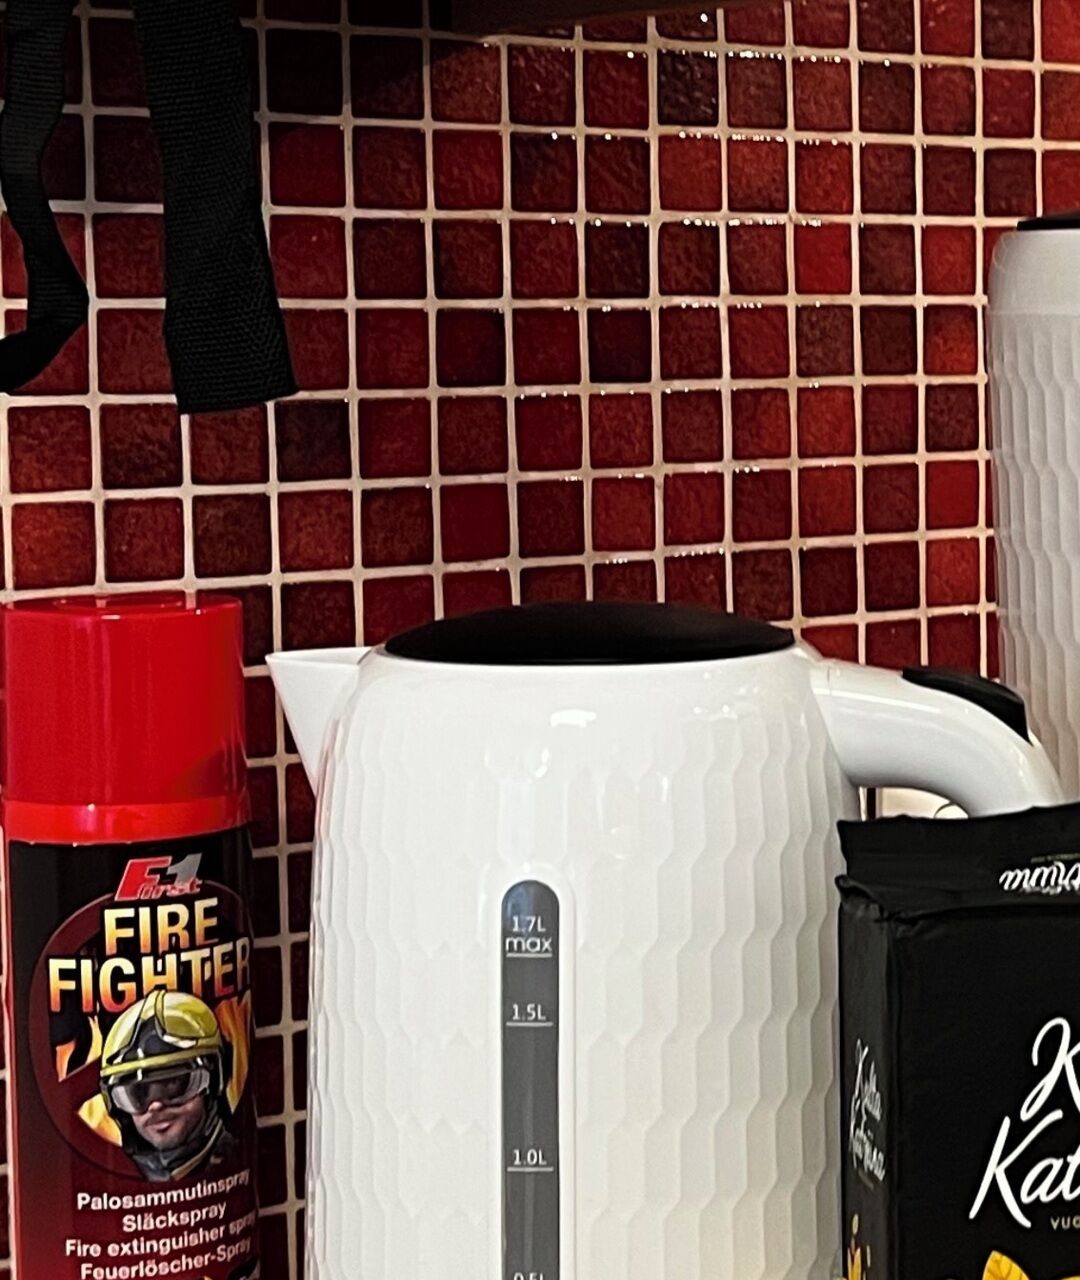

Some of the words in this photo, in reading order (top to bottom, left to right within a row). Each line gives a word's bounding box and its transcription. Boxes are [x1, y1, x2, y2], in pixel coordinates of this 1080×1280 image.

[104, 897, 220, 955] FIRE
[511, 915, 546, 933] 1.7L
[505, 936, 552, 954] max
[49, 936, 250, 1013] FIGHTER
[511, 1004, 547, 1021] 1.5L
[513, 1149, 548, 1166] 1.0L
[77, 1168, 250, 1210] Palosammutinspray
[123, 1201, 227, 1232] Släckspray
[66, 1239, 102, 1257] Fire
[107, 1225, 225, 1256] extinguisher
[81, 1237, 252, 1280] Feuerlöscher-Spray
